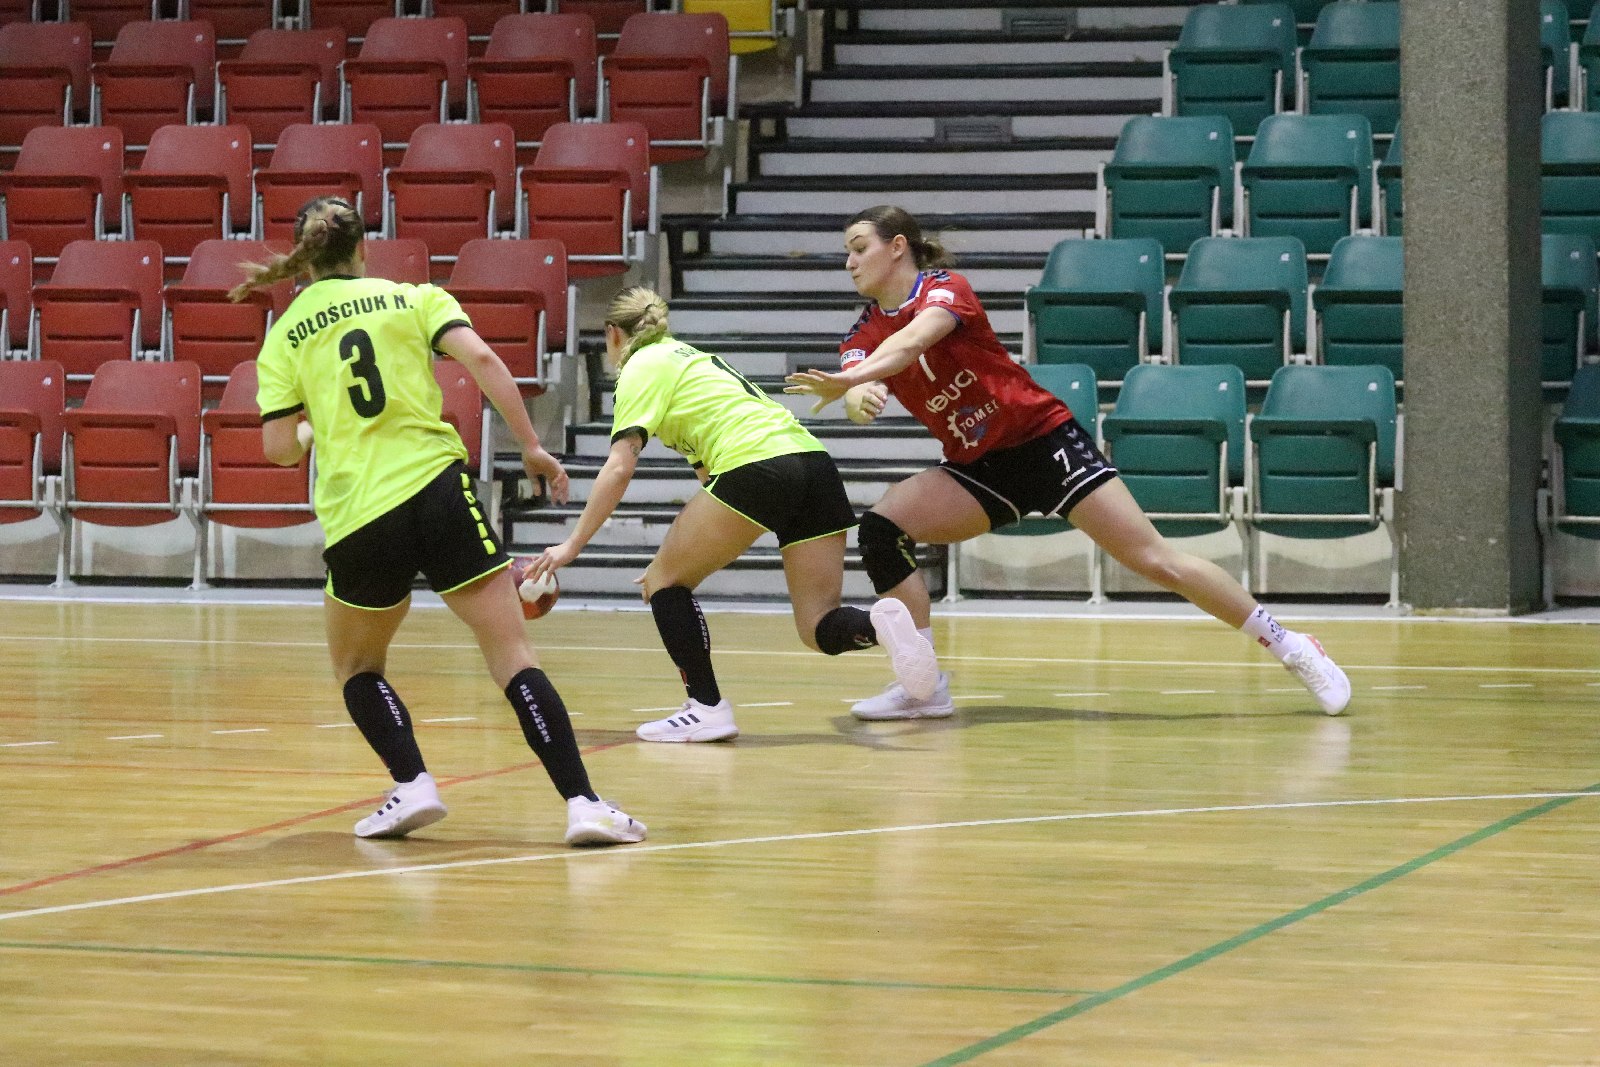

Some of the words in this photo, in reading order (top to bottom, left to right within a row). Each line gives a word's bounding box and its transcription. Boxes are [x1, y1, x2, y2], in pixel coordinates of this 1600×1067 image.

[287, 295, 387, 349] SOŁOŚCIUK
[393, 294, 414, 310] N.
[339, 328, 387, 419] 3
[1053, 447, 1071, 473] 7
